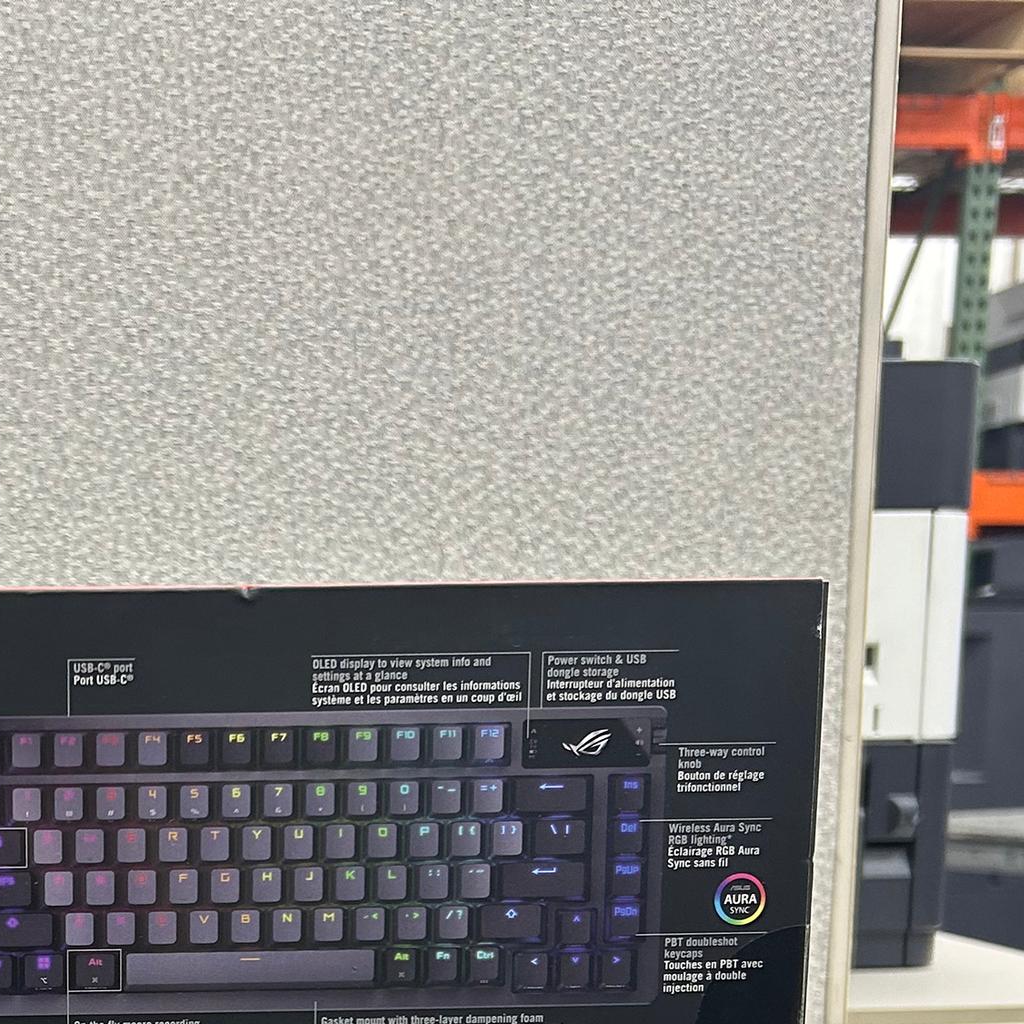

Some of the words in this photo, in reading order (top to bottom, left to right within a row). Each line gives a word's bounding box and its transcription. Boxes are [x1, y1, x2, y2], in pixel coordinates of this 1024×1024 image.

[547, 655, 578, 665] Power
[580, 654, 612, 664] switch
[614, 654, 623, 664] &
[626, 654, 646, 664] USB
[112, 663, 132, 675] port
[547, 667, 580, 679] dongle
[582, 667, 619, 678] storage
[73, 674, 93, 685] Port
[228, 733, 245, 743] F6
[271, 732, 287, 742] F7
[313, 731, 329, 742] F8
[355, 731, 372, 741] F9
[396, 730, 415, 740] F10
[439, 729, 457, 739] F11
[480, 728, 499, 738] F12
[144, 734, 161, 744] F4
[186, 734, 202, 744] F5
[678, 746, 728, 759] Three-way
[731, 746, 764, 756] control
[678, 758, 701, 768] knob
[668, 823, 710, 834] Wireless
[712, 822, 735, 833] Aura
[738, 822, 761, 834] Sync
[668, 834, 687, 846] RGB
[724, 893, 758, 905] AURA
[729, 906, 751, 915] SYNC
